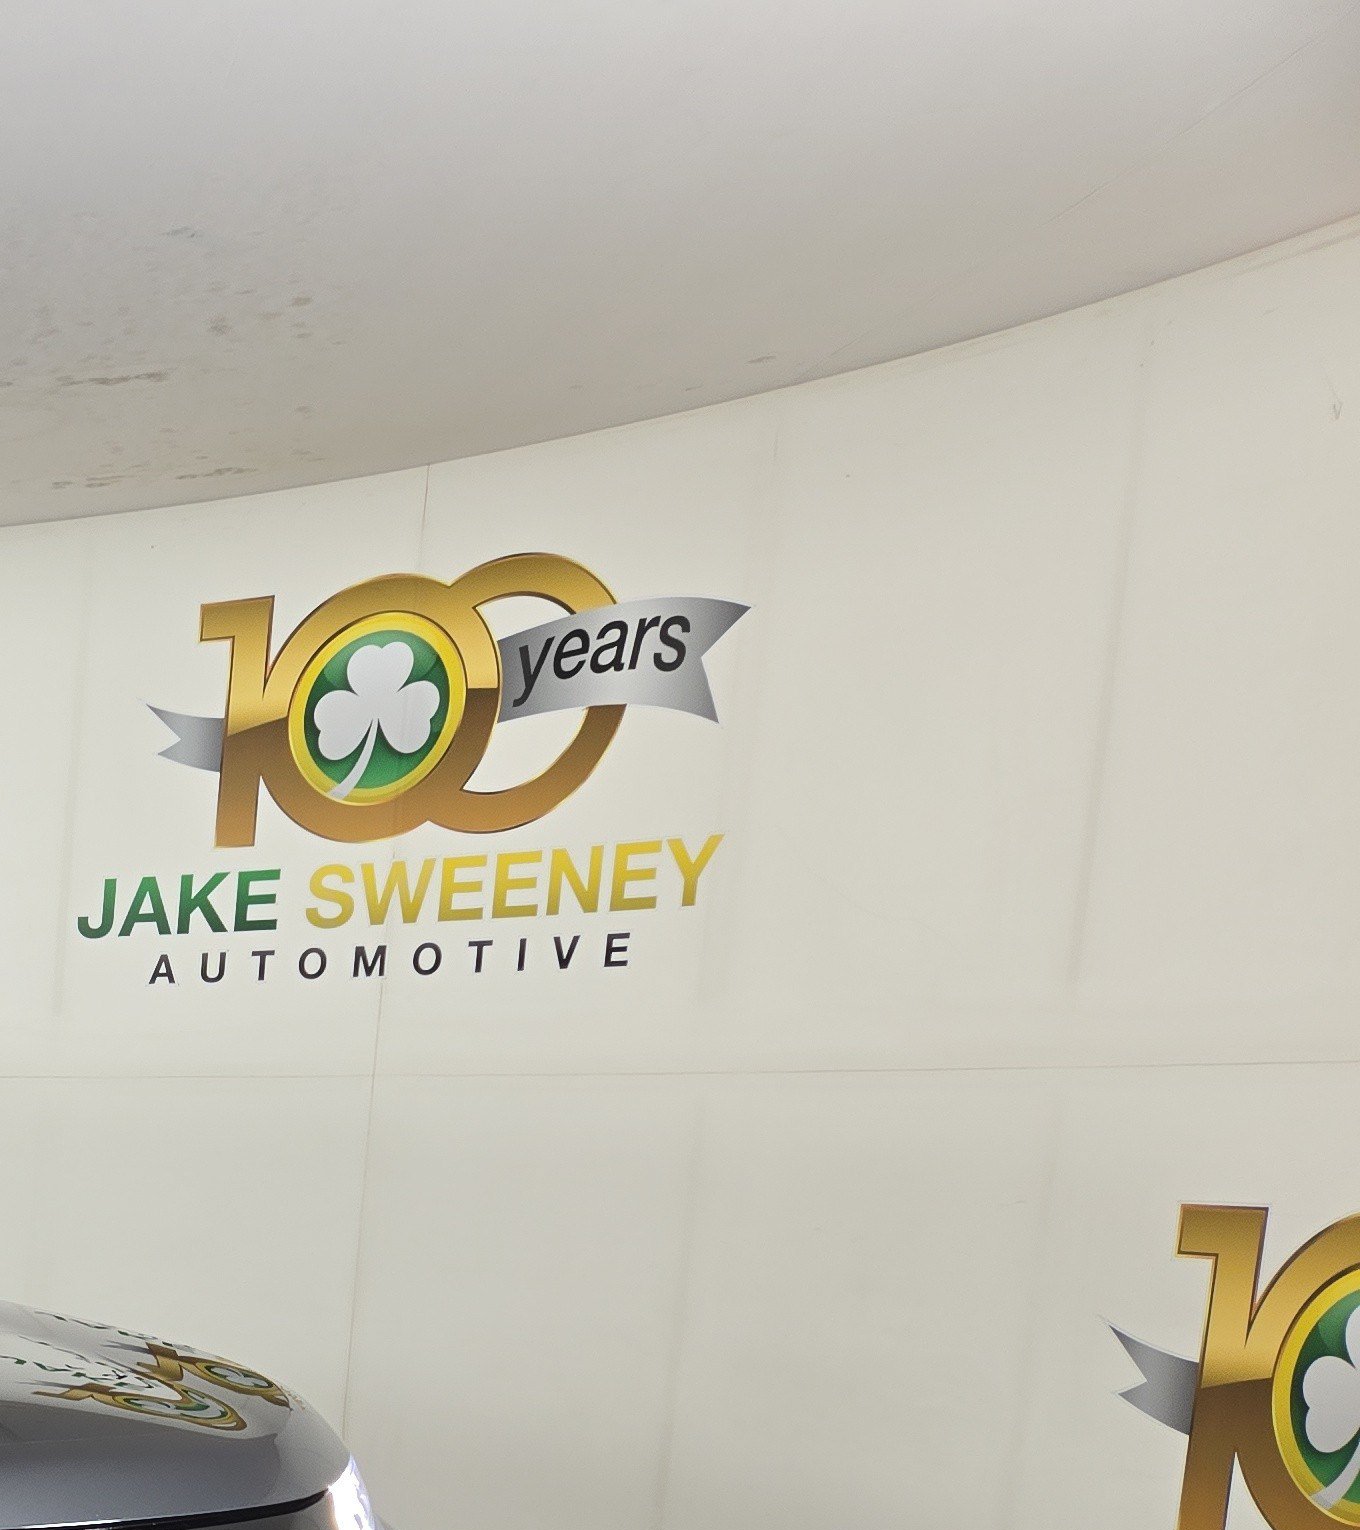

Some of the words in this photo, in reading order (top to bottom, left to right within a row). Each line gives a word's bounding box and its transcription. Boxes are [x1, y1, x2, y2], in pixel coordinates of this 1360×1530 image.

[512, 612, 691, 708] years
[77, 868, 280, 939] JAKE
[305, 834, 725, 930] SWEENEY
[148, 932, 632, 985] AUTOMOTIVE
